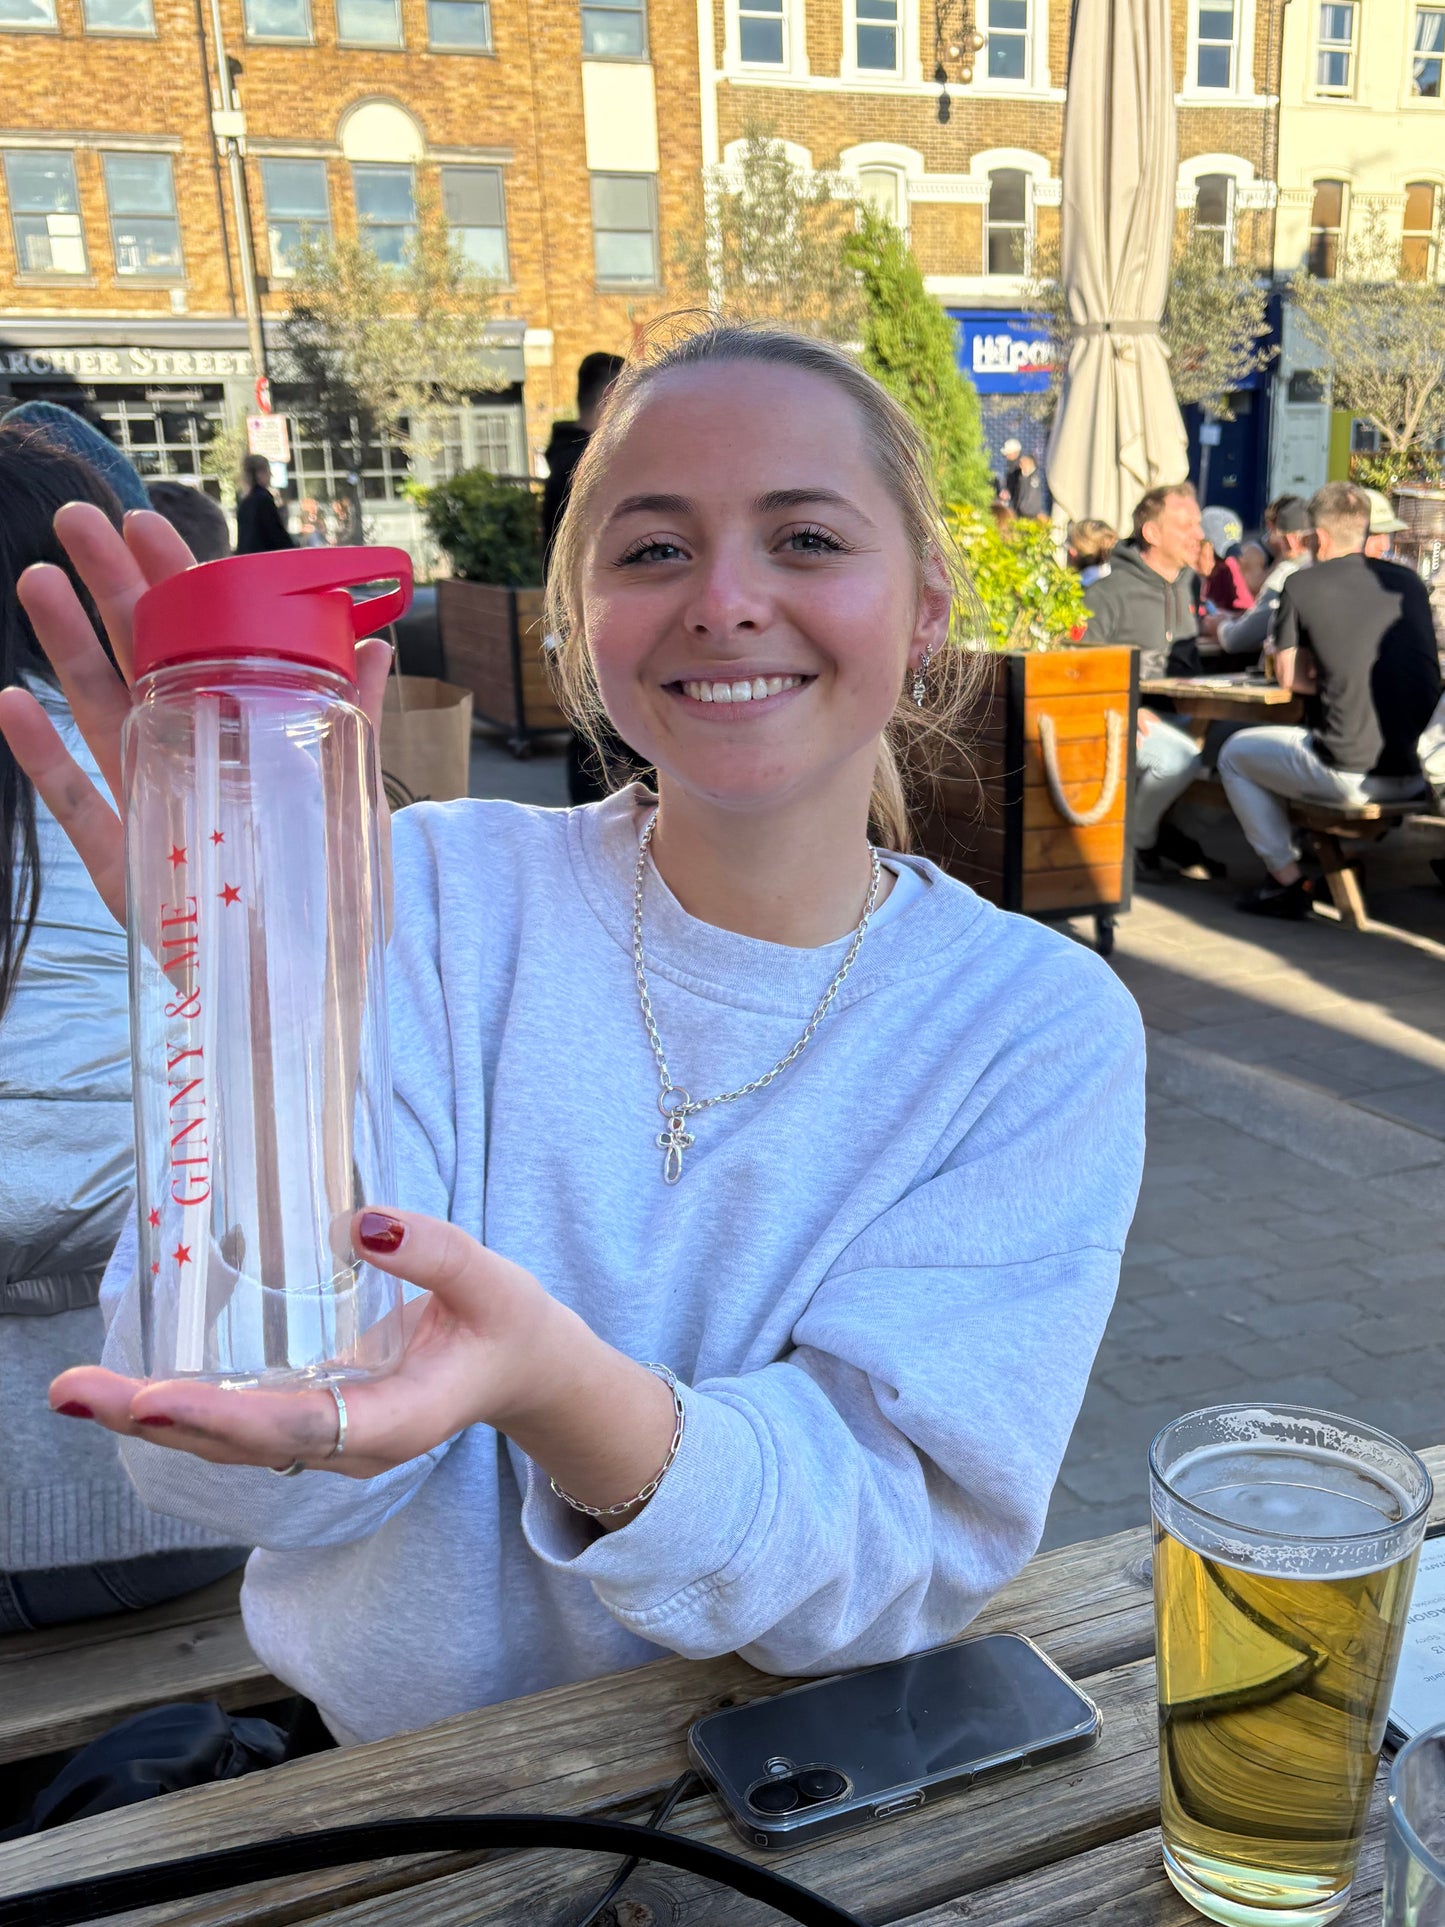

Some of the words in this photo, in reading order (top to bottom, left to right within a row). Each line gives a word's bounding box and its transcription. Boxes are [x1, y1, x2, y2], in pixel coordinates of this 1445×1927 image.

[129, 349, 251, 376] STREET
[161, 896, 199, 971] ME
[164, 986, 201, 1018] &
[166, 1042, 210, 1206] GINNY
